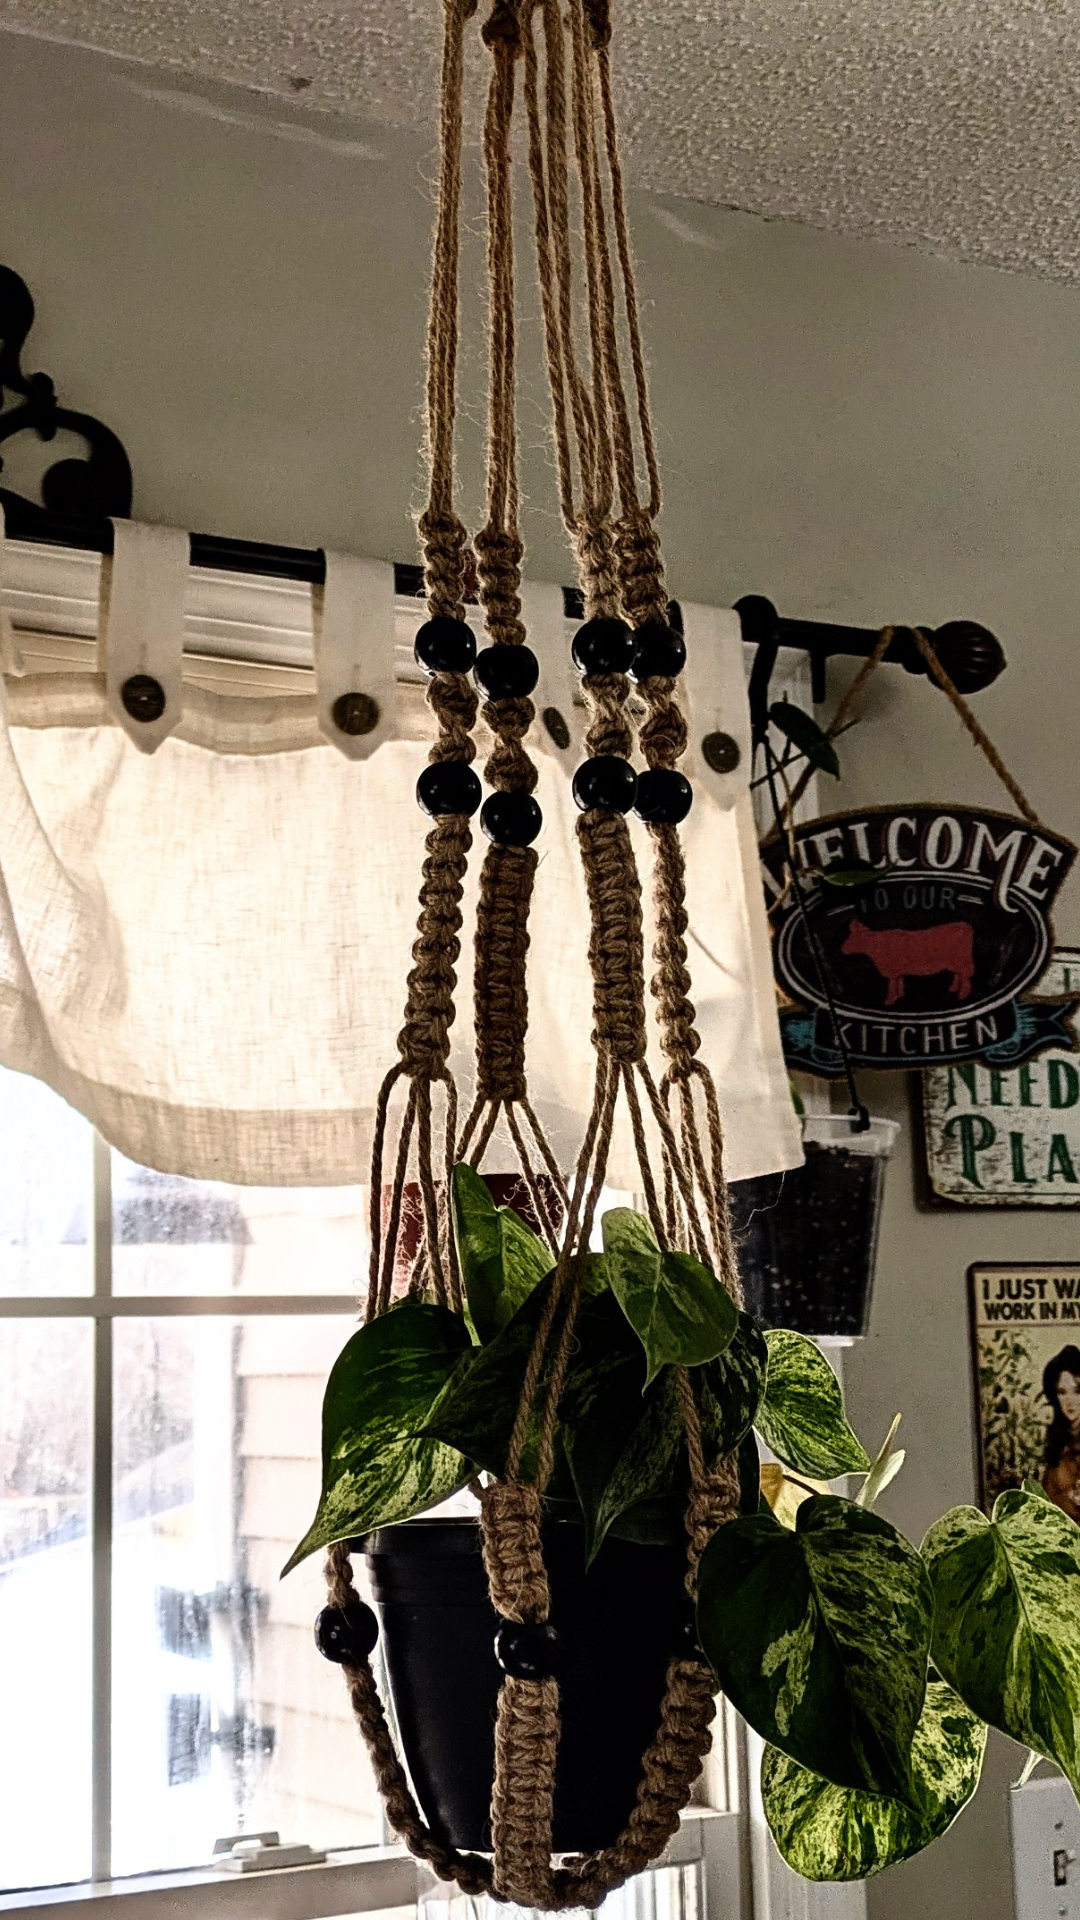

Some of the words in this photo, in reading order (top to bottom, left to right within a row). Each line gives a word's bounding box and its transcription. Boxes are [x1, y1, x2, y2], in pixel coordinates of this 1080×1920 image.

[760, 816, 1063, 913] WELCOME
[902, 885, 957, 910] OUR
[834, 1015, 998, 1055] KITCHEN
[983, 1279, 990, 1300] I
[996, 1279, 1048, 1300] JUST
[984, 1302, 1035, 1320] WORK
[1040, 1302, 1057, 1320] IN
